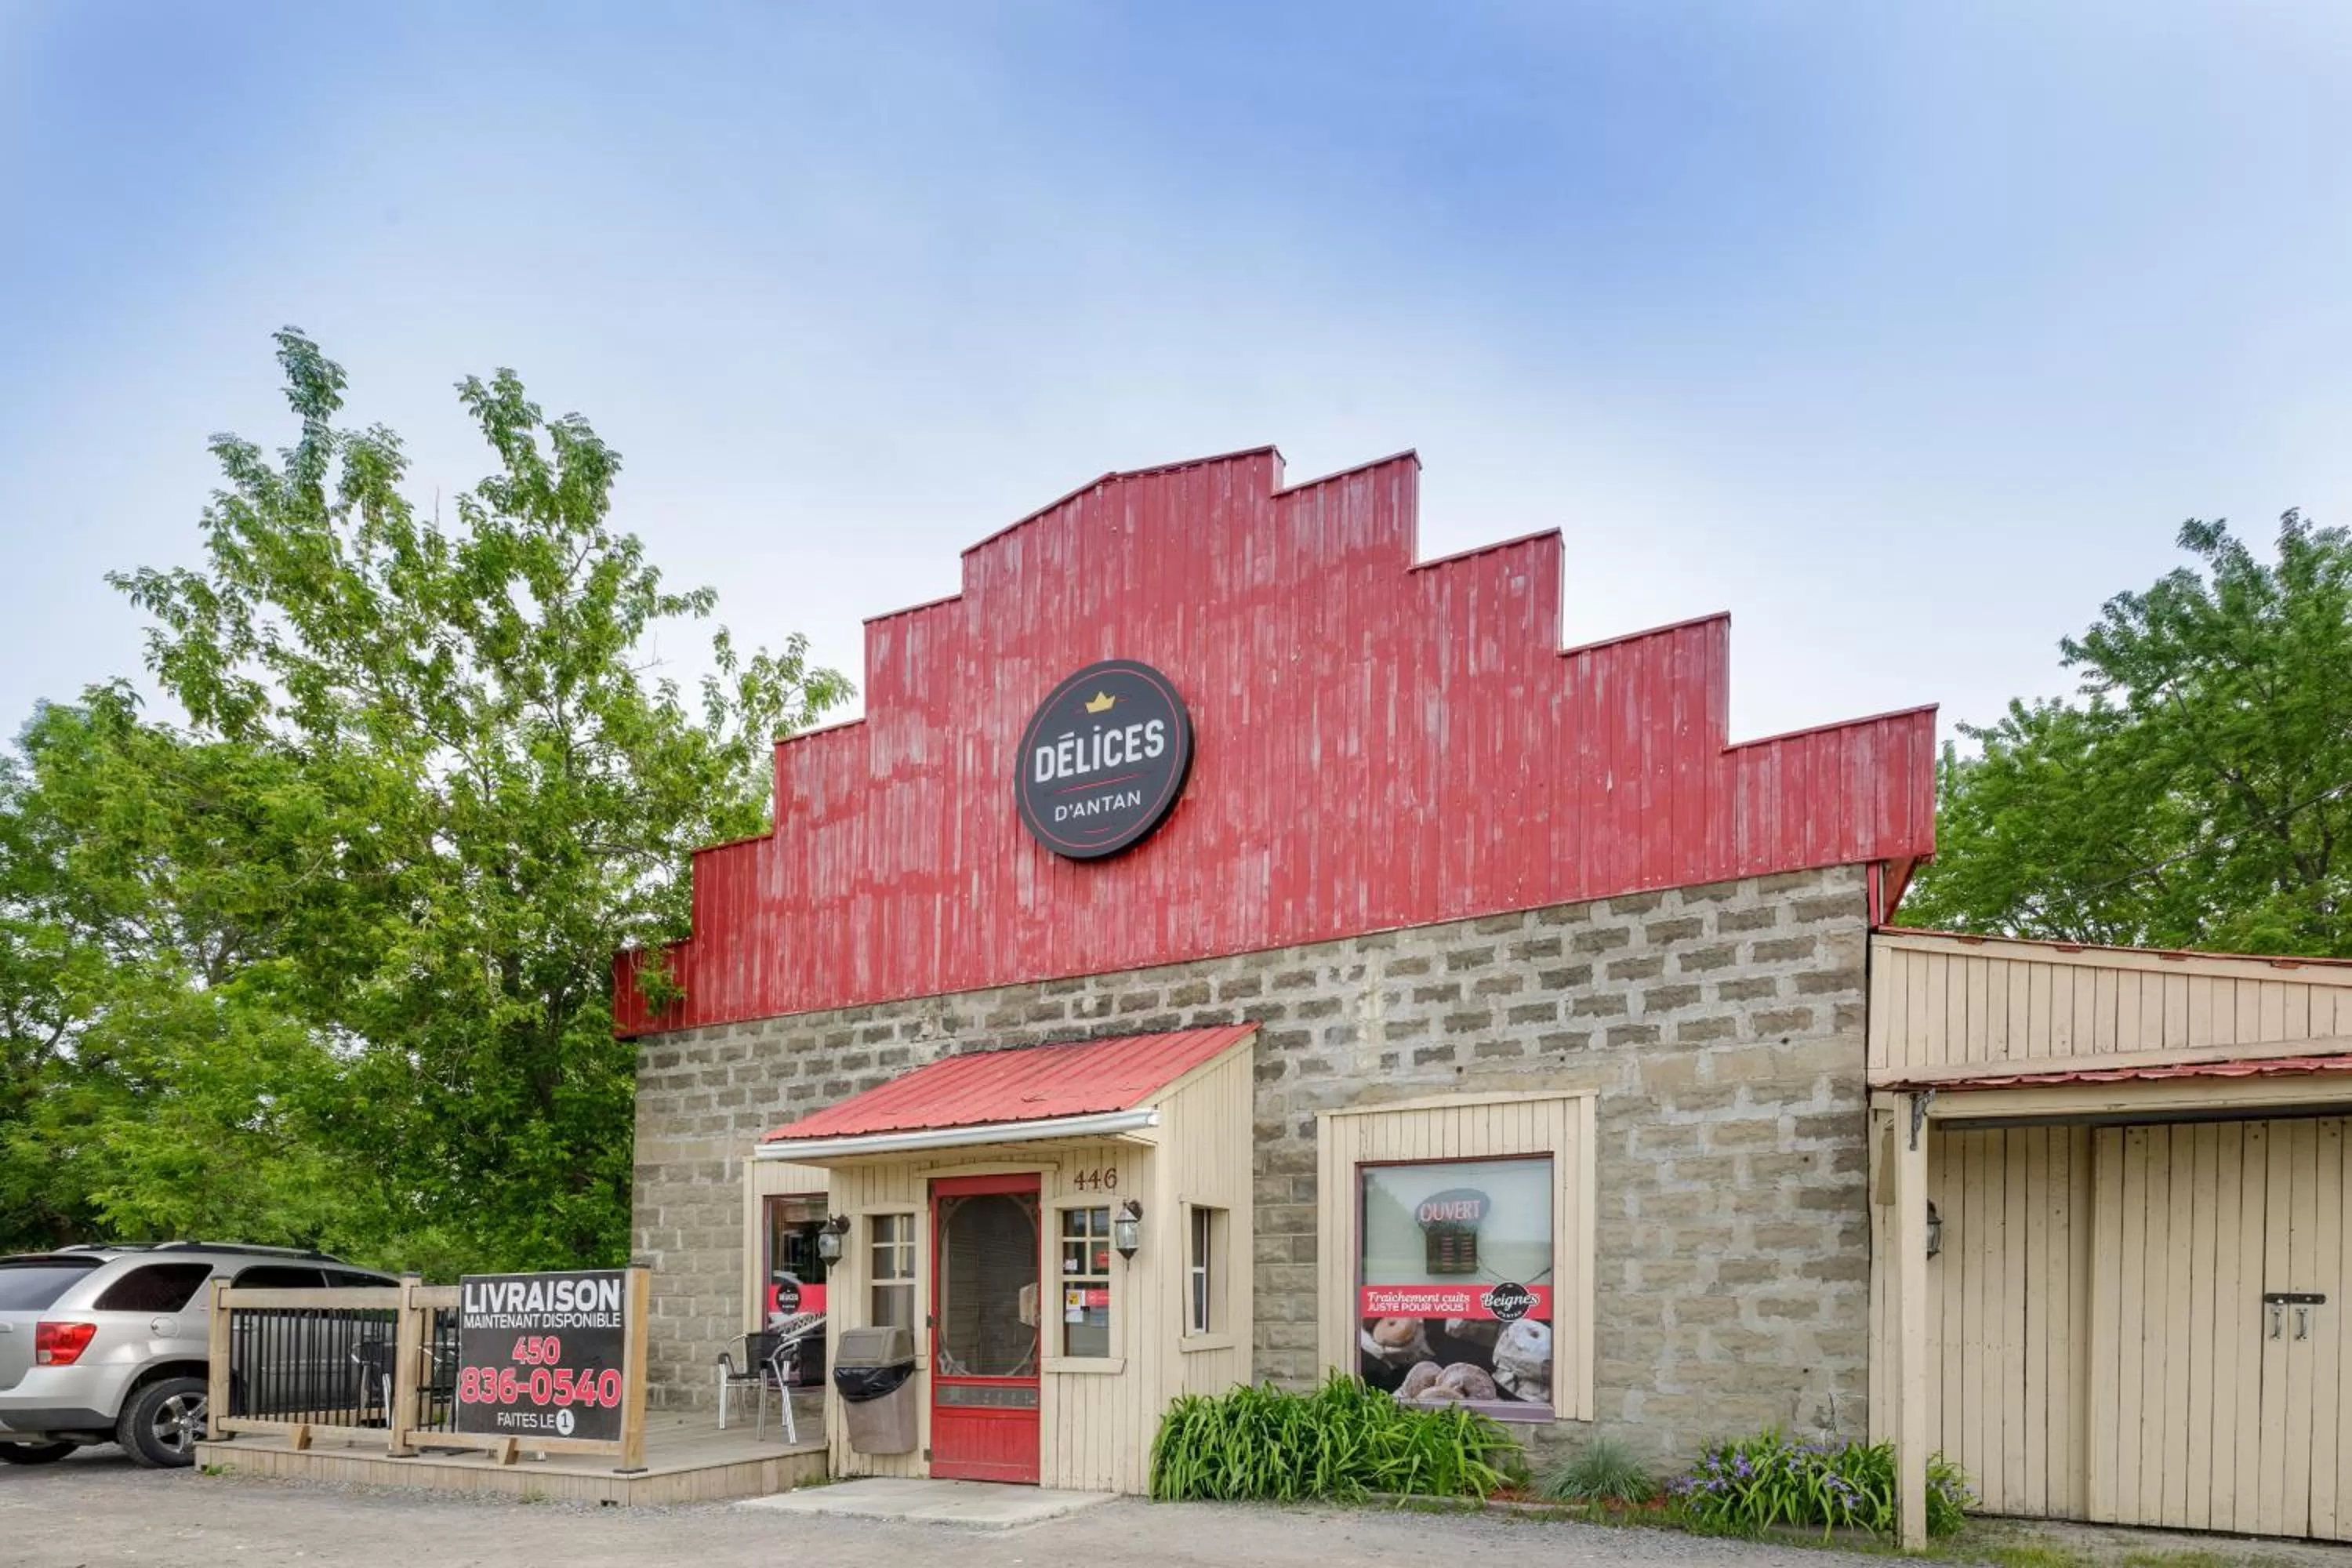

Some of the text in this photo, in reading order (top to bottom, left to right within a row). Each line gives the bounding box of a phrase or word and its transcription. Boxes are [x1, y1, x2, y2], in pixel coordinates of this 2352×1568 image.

[1054, 789, 1142, 822] D'ANTAN
[1074, 1167, 1117, 1191] 446
[1420, 1200, 1480, 1221] OUVERT
[464, 1279, 620, 1313] LIVRAISON
[1443, 1292, 1471, 1303] cuits
[1482, 1294, 1538, 1312] Beignes
[1367, 1302, 1399, 1312] JUSTE
[1401, 1302, 1432, 1312] POUR
[464, 1312, 621, 1329] MAINTENANT DISPONIBLE
[512, 1336, 561, 1365] 450
[459, 1367, 622, 1409] 836-0540
[497, 1412, 569, 1428] FAITES LE 1
